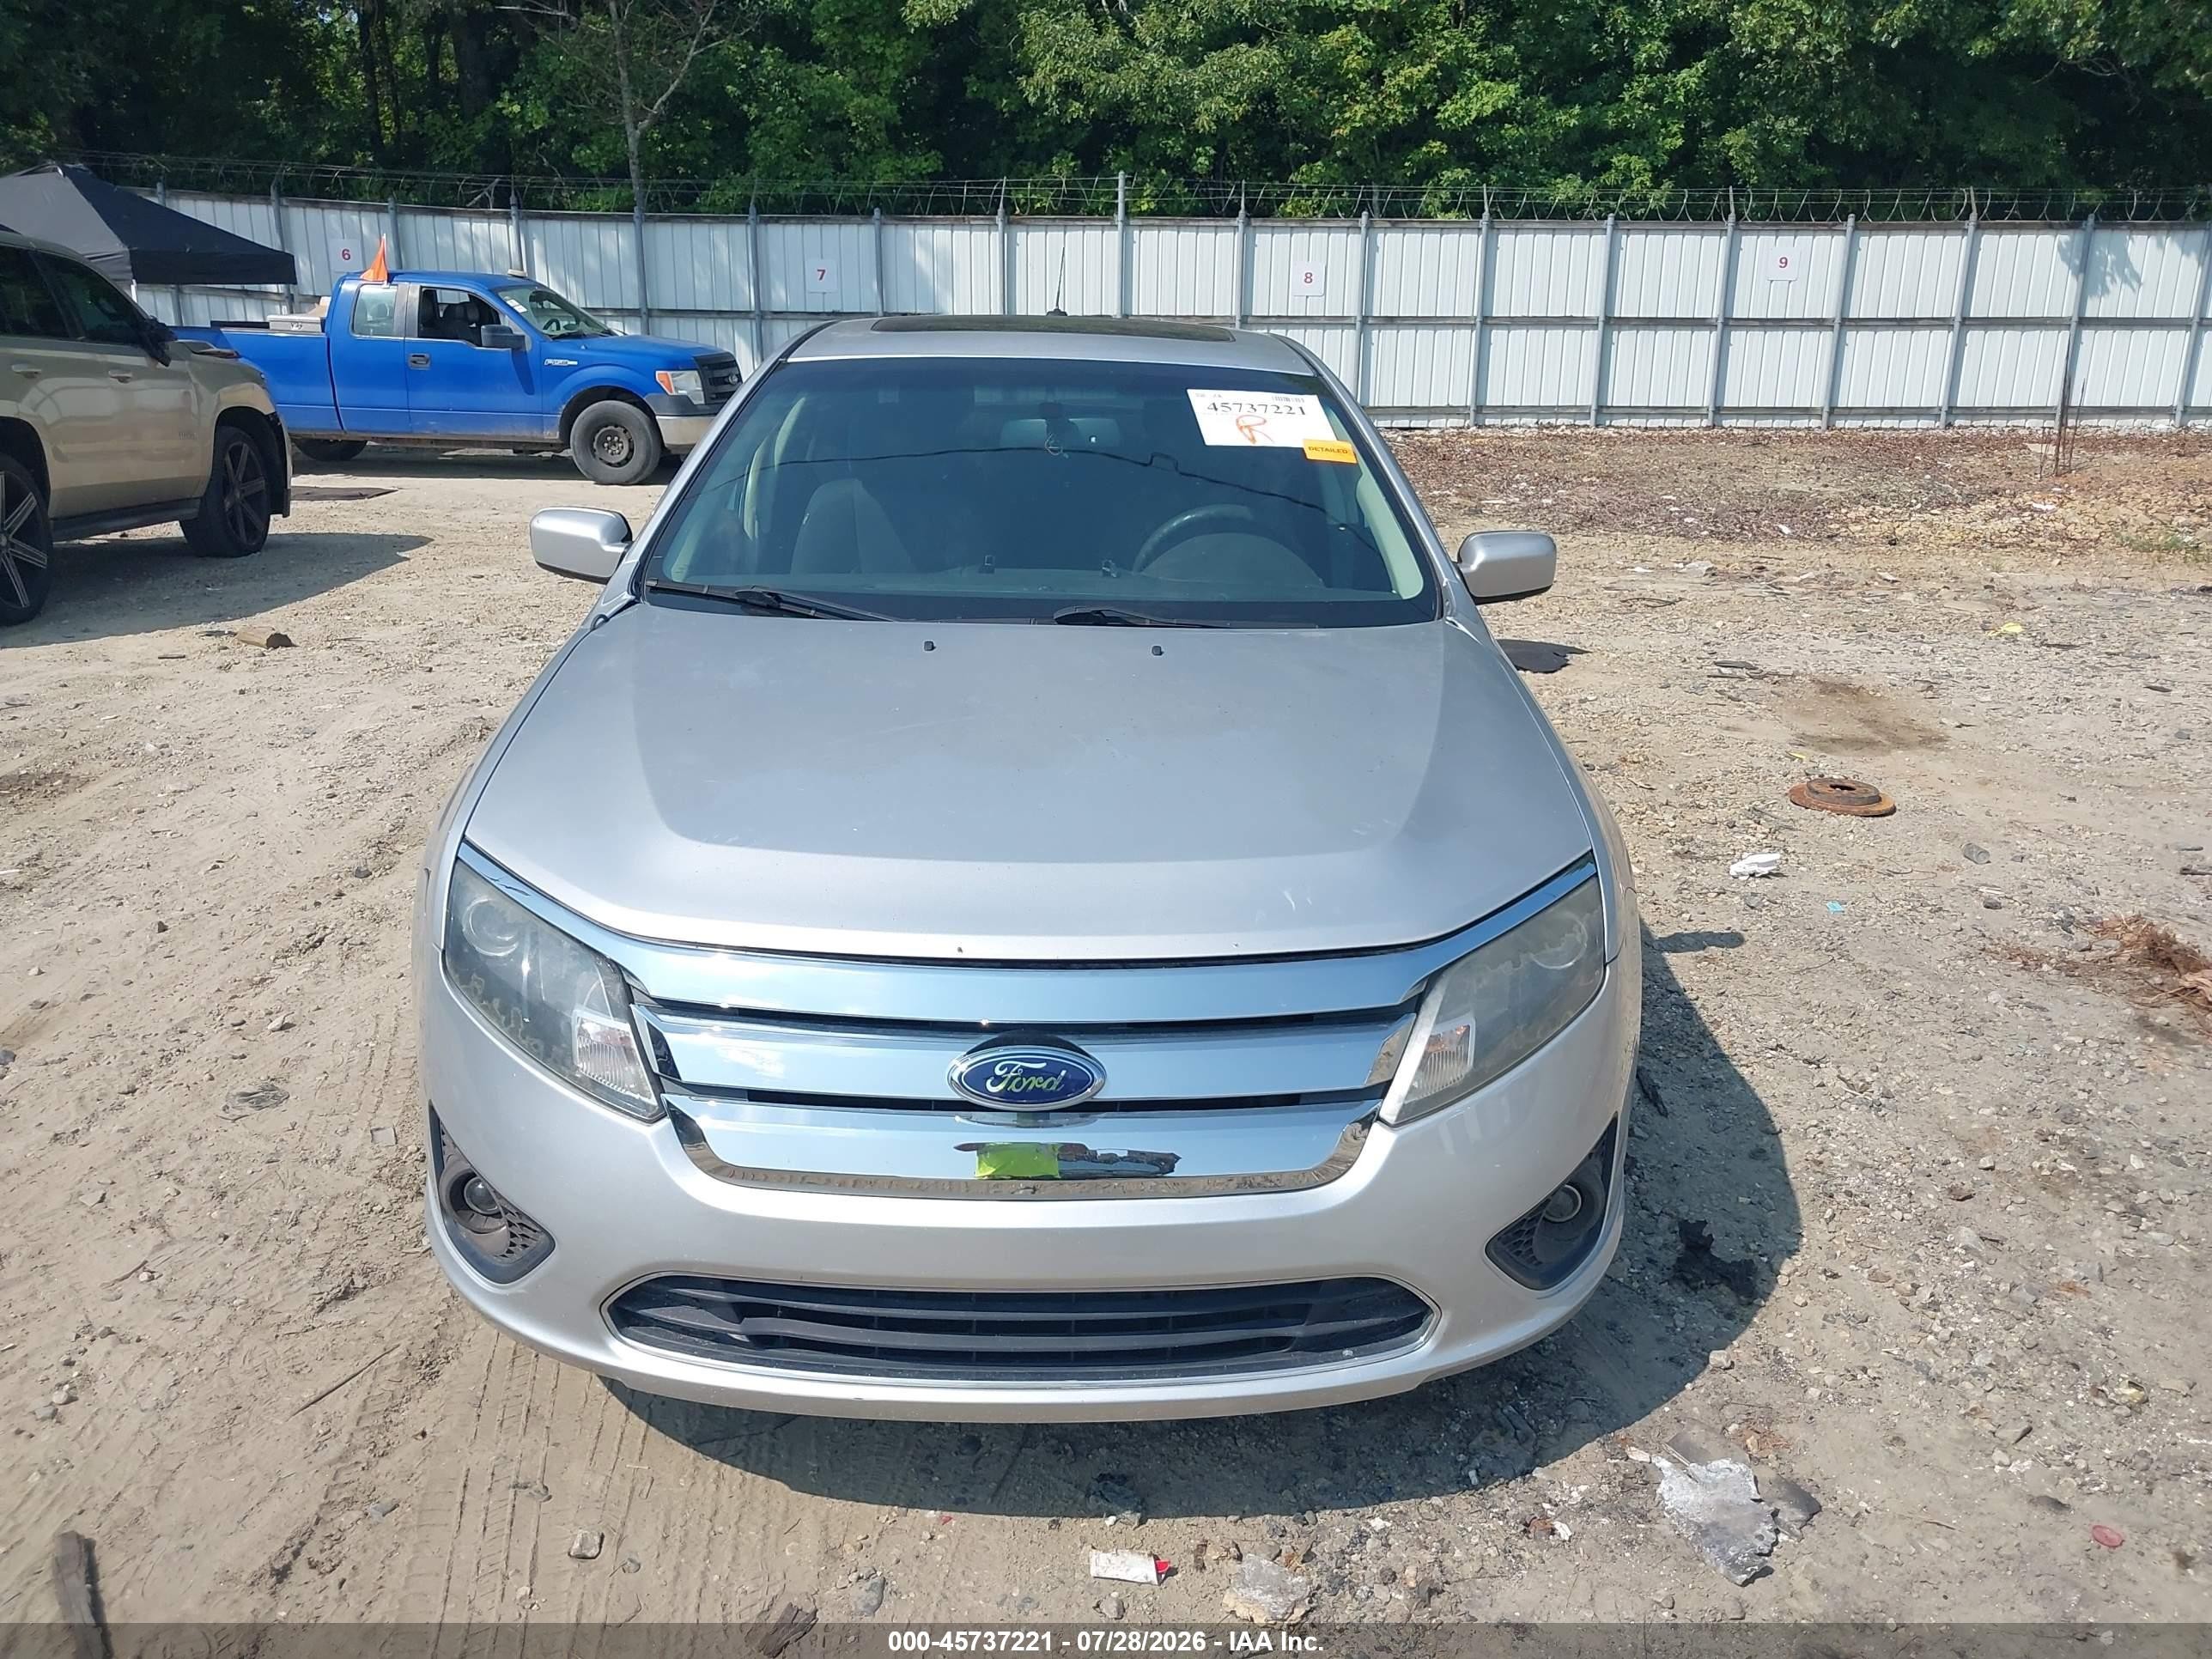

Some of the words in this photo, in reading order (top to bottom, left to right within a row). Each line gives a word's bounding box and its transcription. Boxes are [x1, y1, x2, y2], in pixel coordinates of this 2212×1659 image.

[342, 248, 351, 261] 6
[1778, 256, 1788, 269] 9
[817, 269, 826, 281] 7
[1304, 271, 1313, 283] 8
[1206, 402, 1306, 416] 45737221
[1308, 446, 1348, 454] DETAILED
[986, 1060, 1066, 1092] Ford
